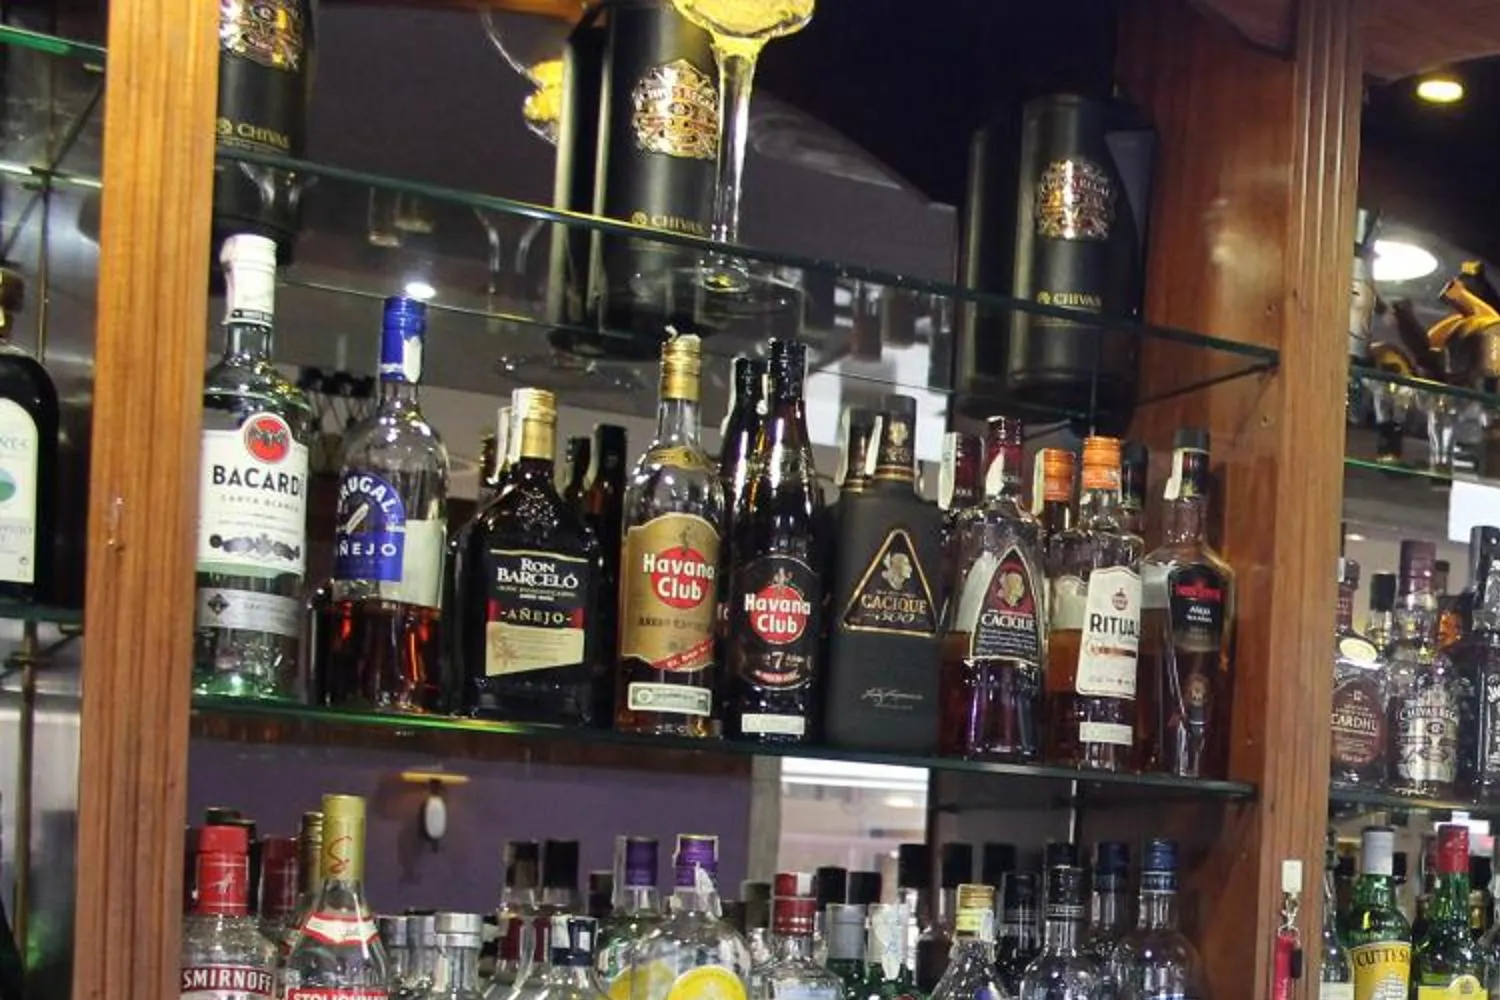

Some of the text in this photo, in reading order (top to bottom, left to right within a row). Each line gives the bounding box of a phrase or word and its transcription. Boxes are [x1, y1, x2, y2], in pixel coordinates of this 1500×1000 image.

[496, 564, 579, 590] BARCELÓ
[521, 557, 556, 575] RON
[642, 552, 715, 580] Havana
[656, 575, 702, 600] Club
[744, 592, 811, 615] Havana
[861, 593, 929, 614] CACIQUE
[756, 612, 799, 635] Club
[981, 612, 1036, 630] CACIQUE
[183, 966, 273, 993] SMIRNOFF
